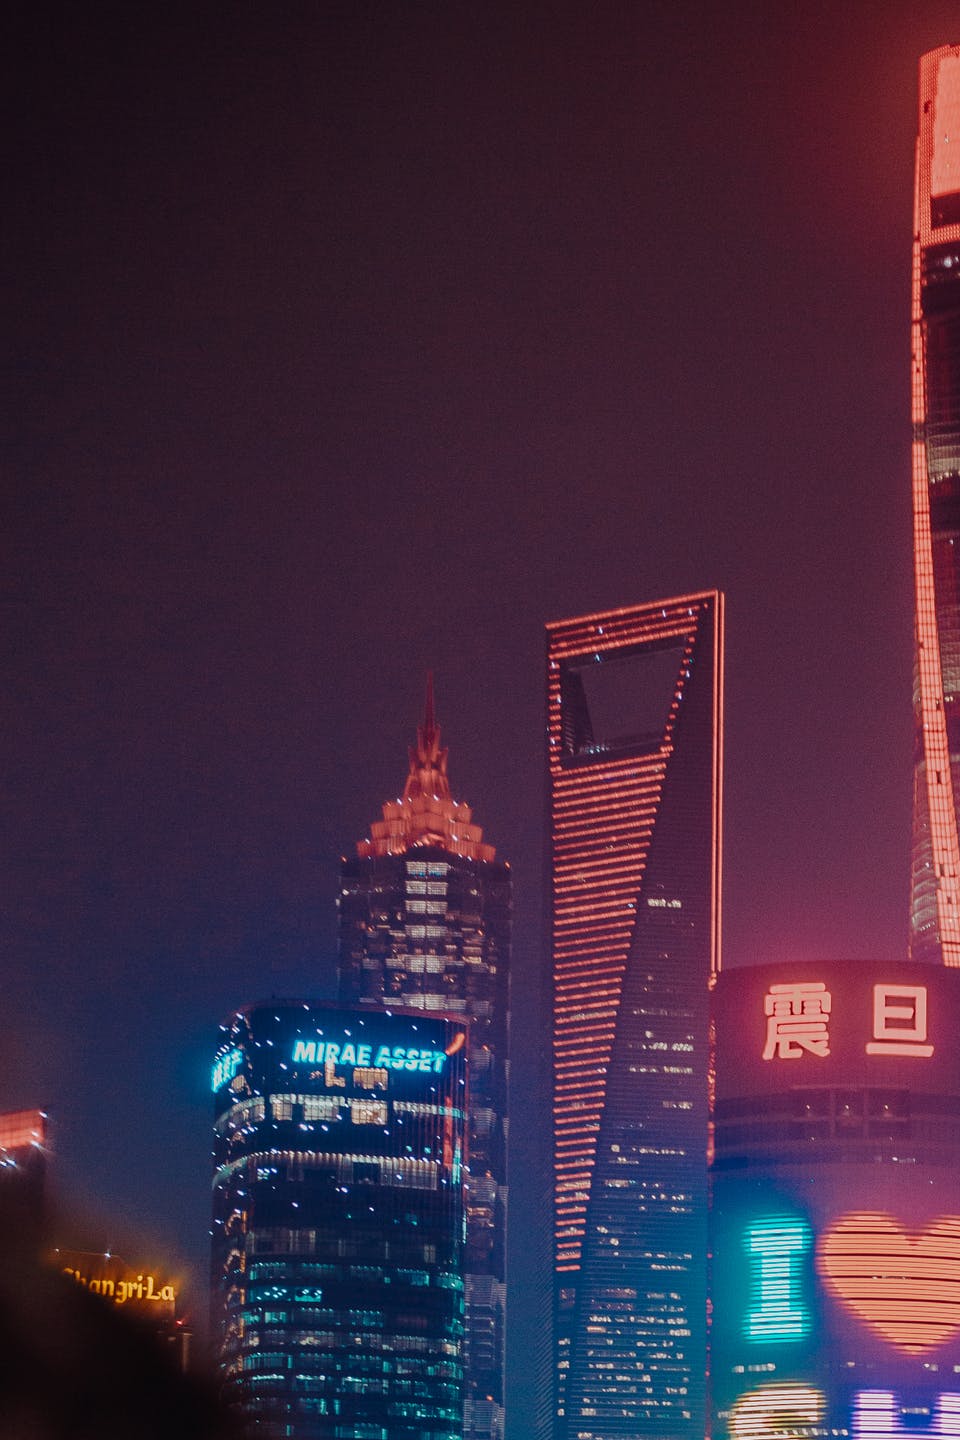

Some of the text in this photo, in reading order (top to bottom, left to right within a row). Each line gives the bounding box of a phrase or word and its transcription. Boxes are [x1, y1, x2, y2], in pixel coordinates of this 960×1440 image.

[762, 982, 935, 1060] 震旦
[293, 1040, 447, 1073] MIRAE ASSET
[63, 1266, 176, 1303] angri-La
[743, 1210, 814, 1346] I
